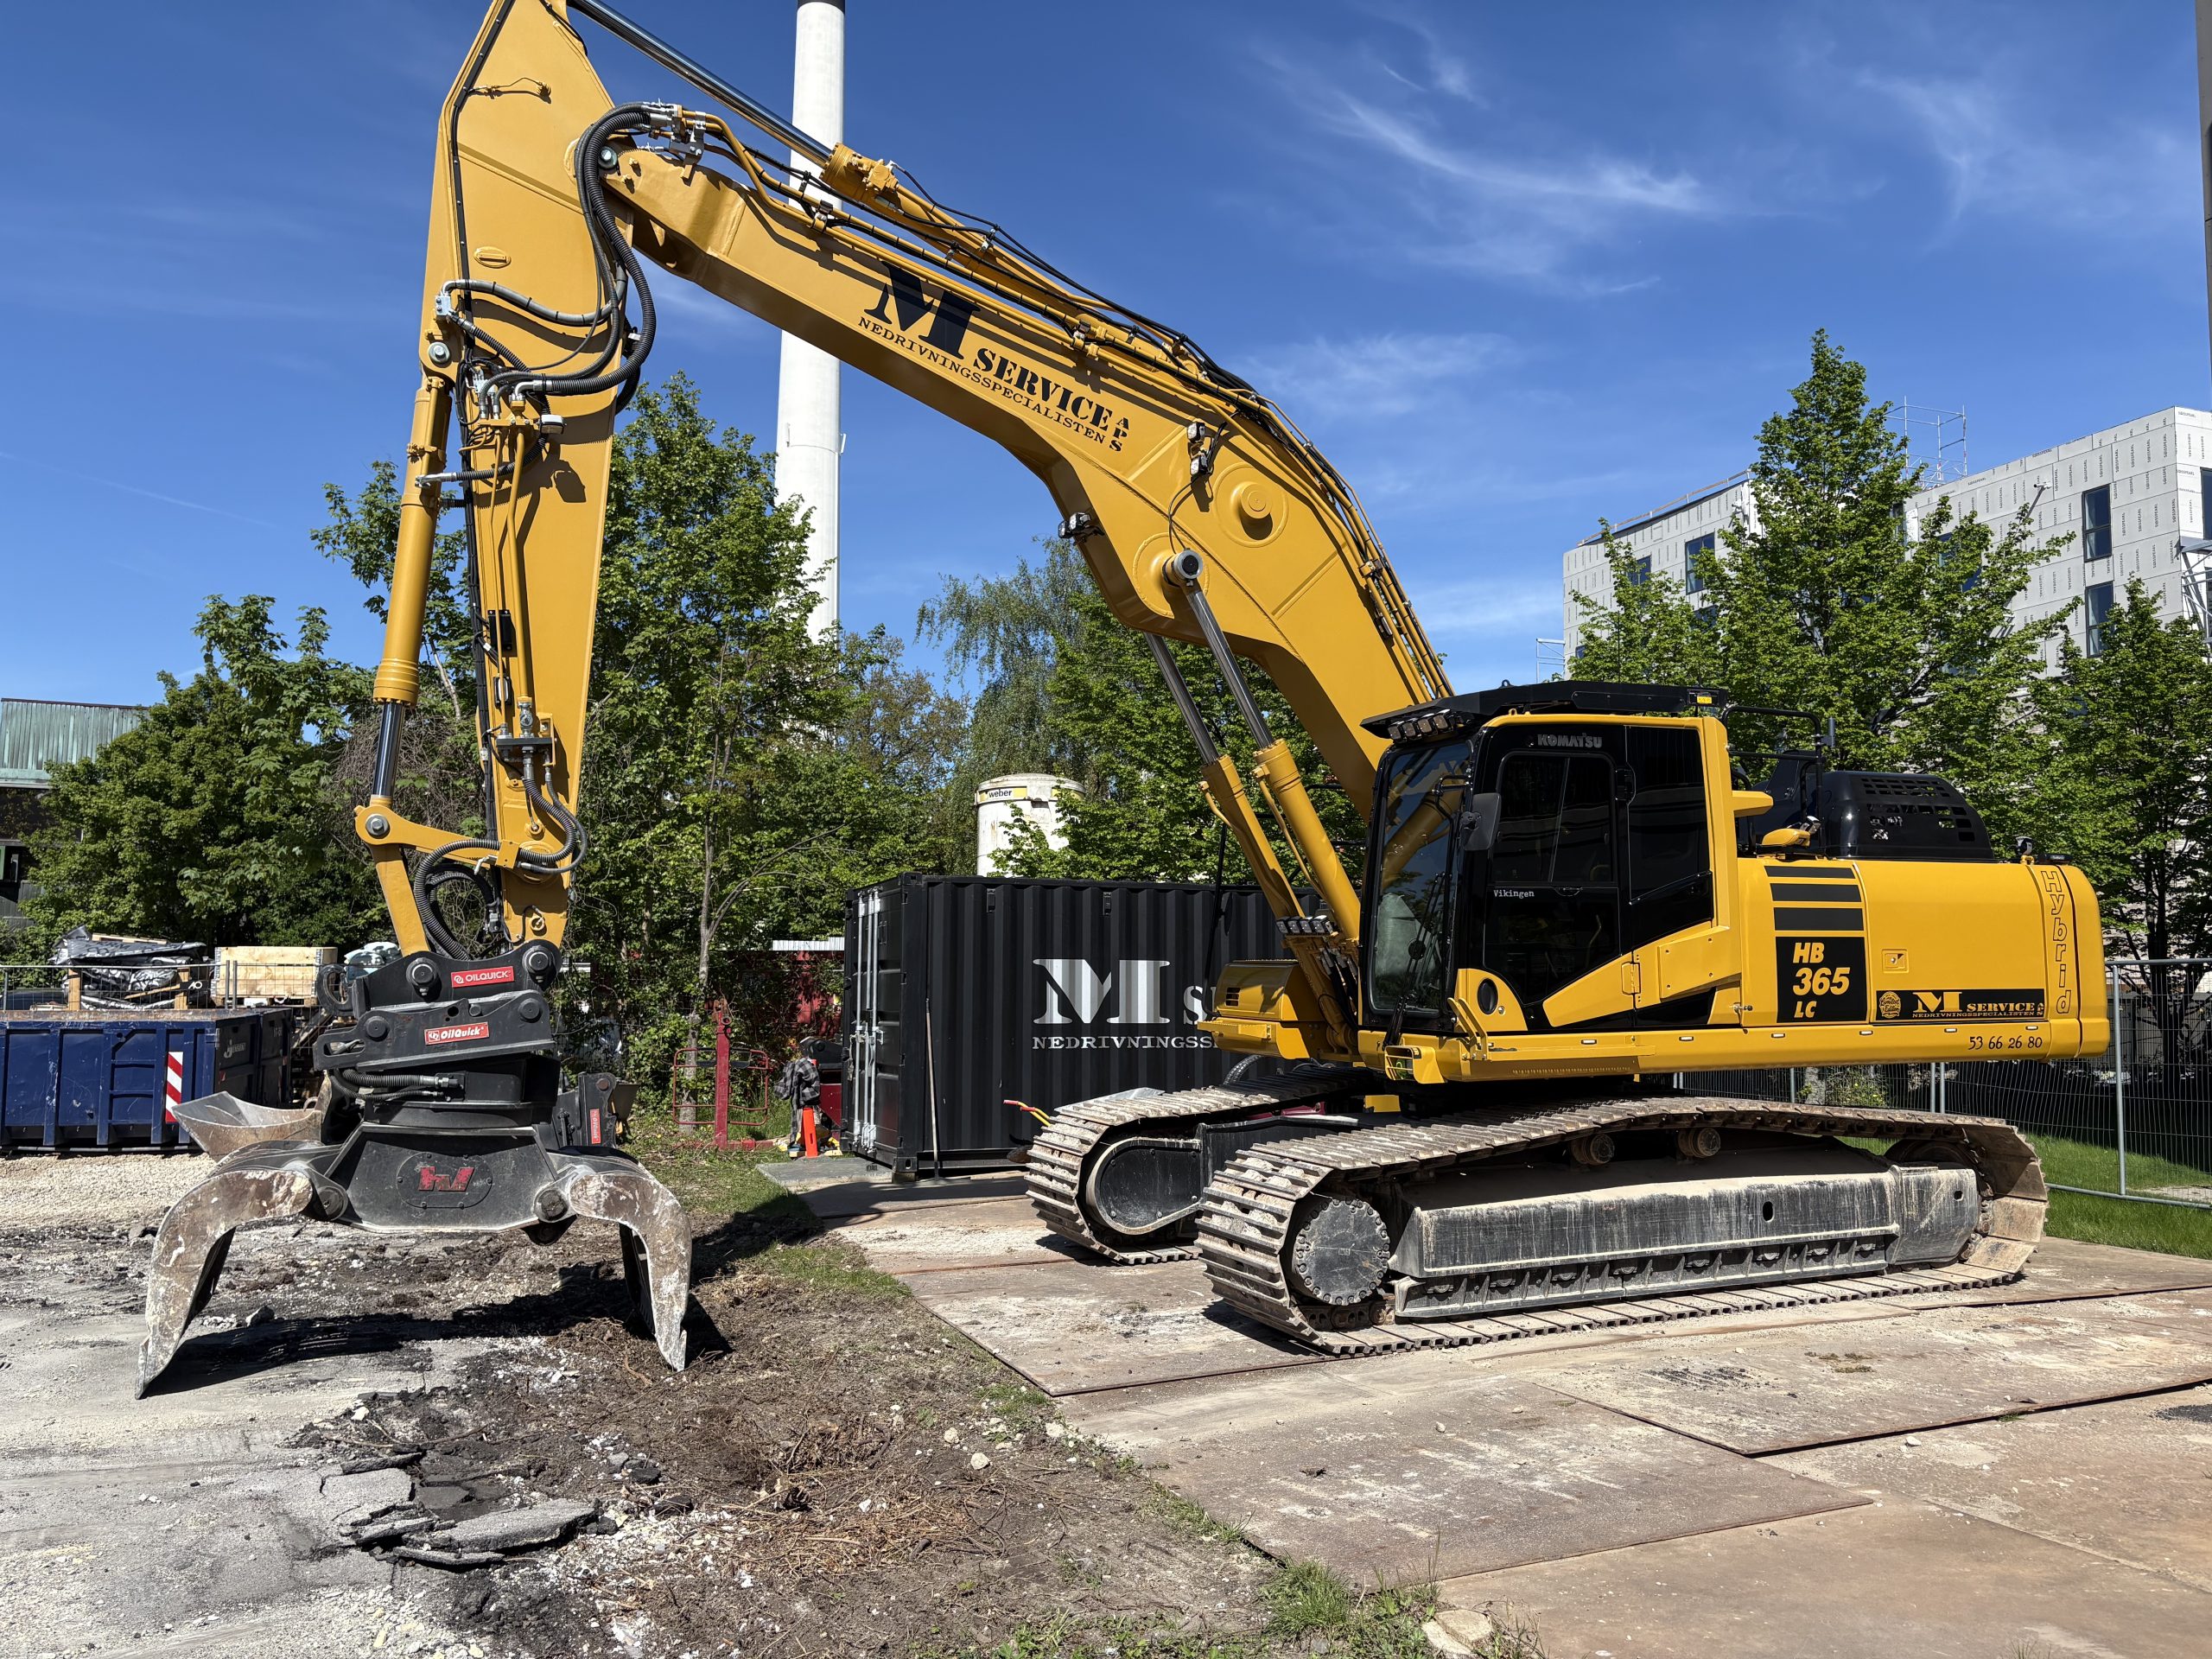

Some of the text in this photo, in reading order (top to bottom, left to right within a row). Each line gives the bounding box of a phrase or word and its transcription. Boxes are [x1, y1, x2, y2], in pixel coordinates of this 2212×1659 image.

[864, 261, 981, 359] M
[973, 346, 1114, 431] SERVICE
[858, 317, 1106, 442] NEDRIVNINGSSPECIALISTEN
[1537, 733, 1603, 749] KOMATSU
[988, 789, 1013, 798] weber
[1493, 889, 1535, 899] Vikingen
[2041, 870, 2072, 1014] Hybrid
[1793, 942, 1825, 963] HB
[466, 970, 508, 982] OILQUICK
[1792, 967, 1850, 995] 365
[1033, 959, 1171, 1024] M
[1794, 1001, 1817, 1019] LC
[1912, 992, 1963, 1013] M
[1967, 1002, 2035, 1012] SERVICE
[441, 1026, 480, 1039] OilQuick
[1033, 1036, 1217, 1050] NEDRIVNINGSS
[1967, 1035, 2043, 1051] 53 66 26 80
